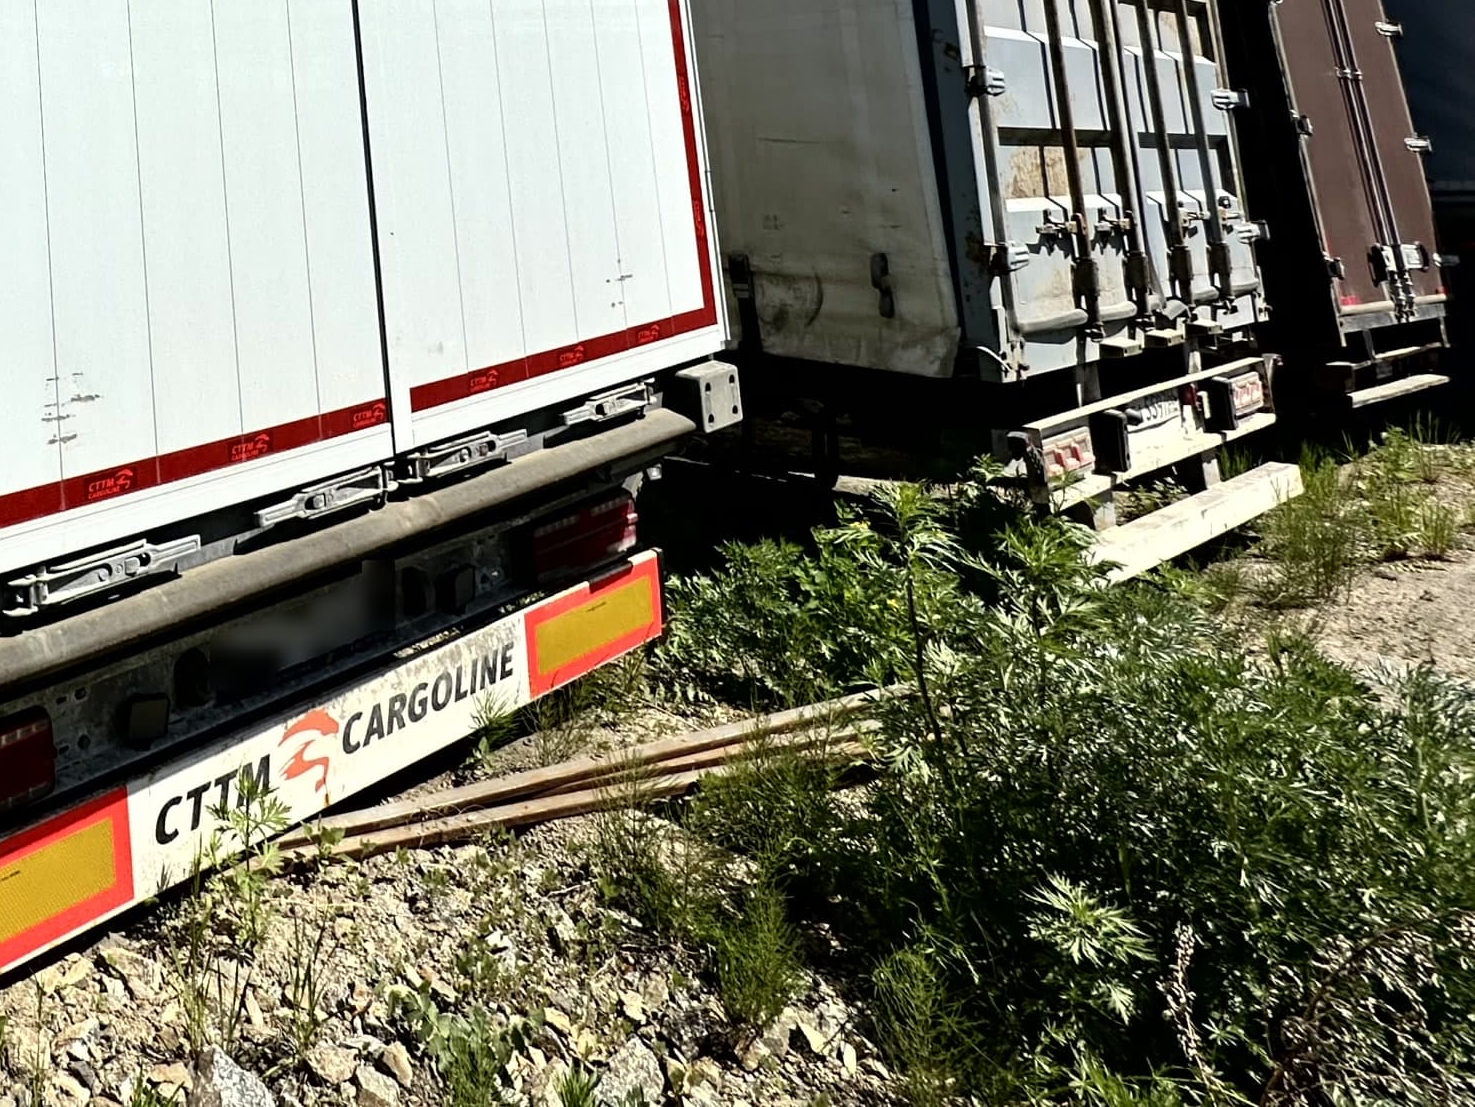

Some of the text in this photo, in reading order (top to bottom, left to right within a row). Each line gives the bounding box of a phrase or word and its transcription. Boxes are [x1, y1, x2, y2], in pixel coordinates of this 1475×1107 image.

[232, 441, 254, 454] CTTM
[89, 477, 115, 492] CTTM
[155, 640, 515, 845] CTTM CARGOLINE
